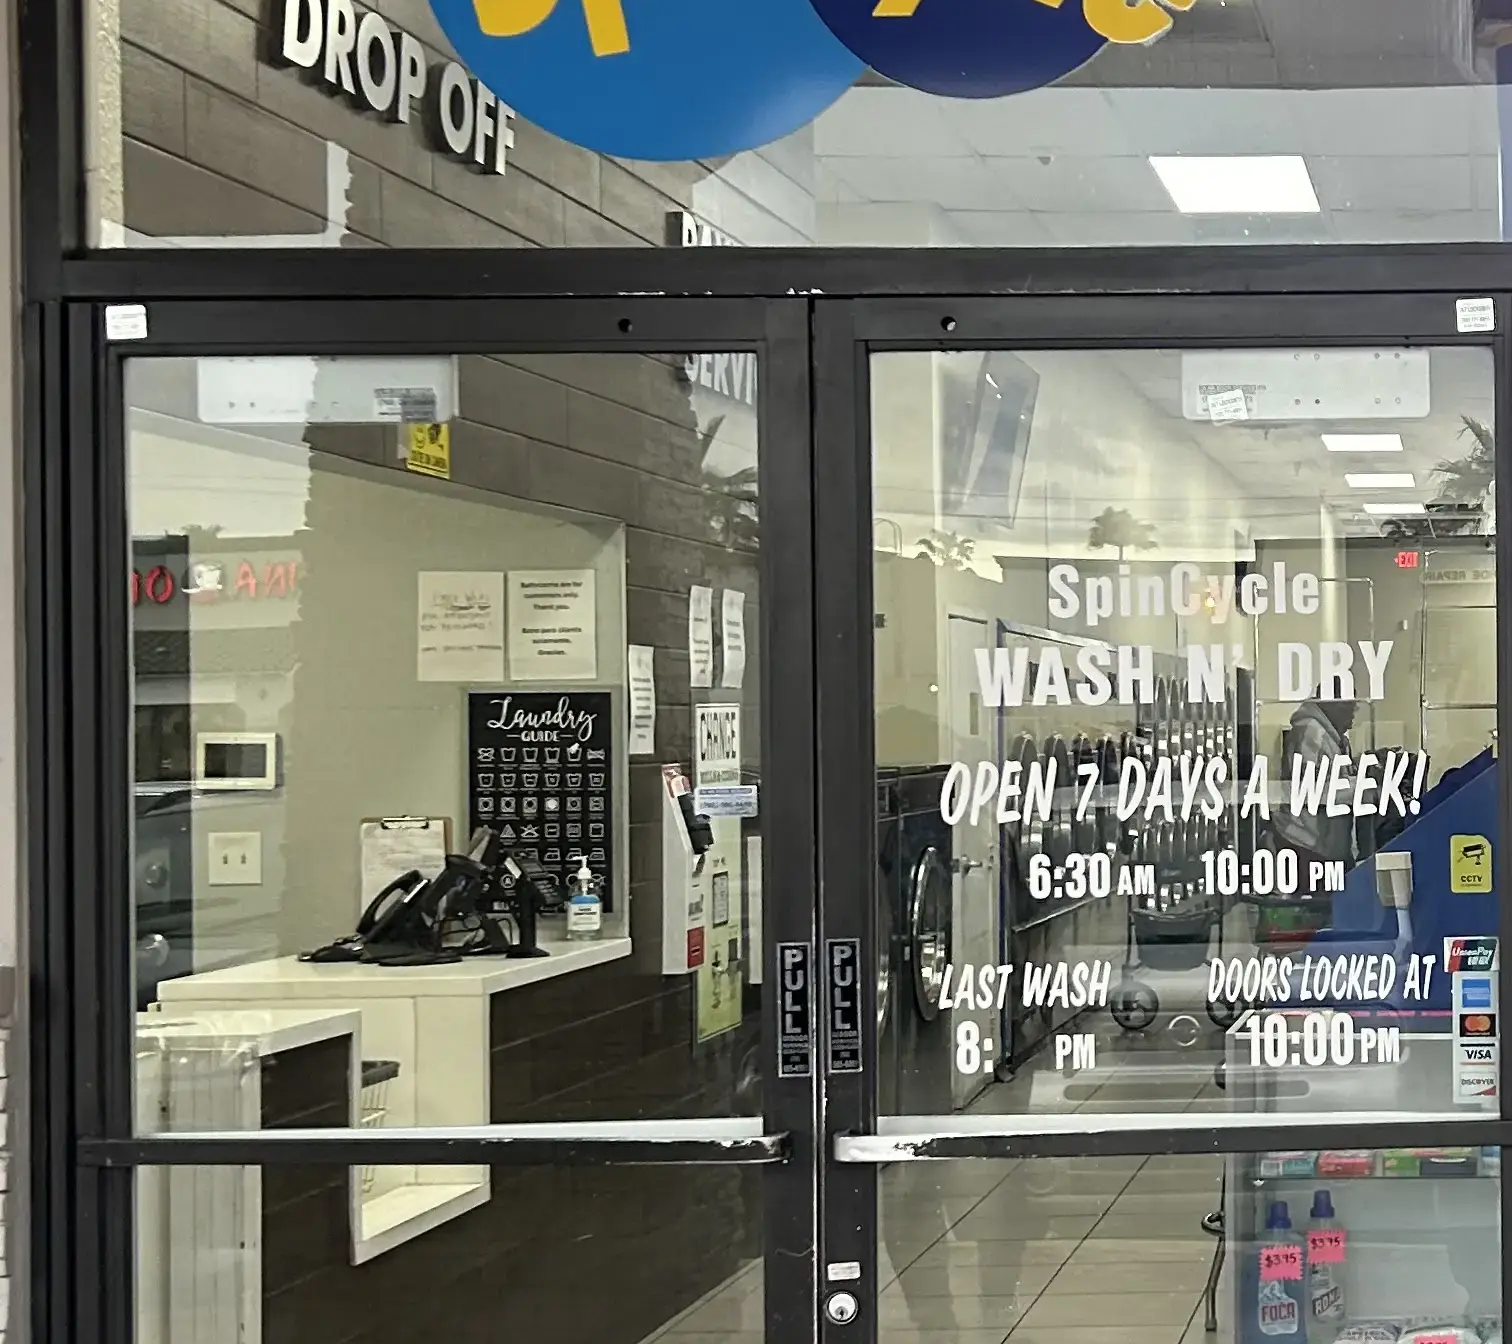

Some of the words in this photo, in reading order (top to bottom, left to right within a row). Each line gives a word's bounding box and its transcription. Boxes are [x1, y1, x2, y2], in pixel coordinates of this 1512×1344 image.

[438, 61, 517, 176] OFF
[1047, 561, 1321, 627] SpinCycle
[974, 644, 1154, 707] WASH
[1277, 640, 1395, 703] DRY
[486, 696, 598, 742] Laundry
[520, 731, 560, 742] GUIDE
[939, 757, 1059, 827] OPEN
[1075, 762, 1101, 822] 7
[1116, 754, 1229, 824] DAYS
[1240, 755, 1272, 821] A
[1289, 749, 1426, 819] WEEK!
[1028, 852, 1112, 899] 6:30
[1117, 864, 1156, 897] AM
[1200, 848, 1299, 896] 10:00
[1309, 861, 1345, 892] PM
[1460, 875, 1483, 883] CCTV
[784, 948, 804, 1034] PULL
[833, 944, 853, 1030] PULL
[938, 961, 1014, 1010] LAST
[1021, 960, 1113, 1009] WASH
[1206, 956, 1294, 1005] DOORS
[1298, 954, 1397, 1003] LOCKED
[1403, 953, 1437, 1002] AT
[1055, 1033, 1096, 1070] PM
[1246, 1012, 1355, 1067] 10:00
[1360, 1025, 1401, 1064] PM
[1465, 1049, 1492, 1060] VISA
[1461, 1078, 1495, 1086] DISCOVER
[1261, 1302, 1296, 1323] FOCA
